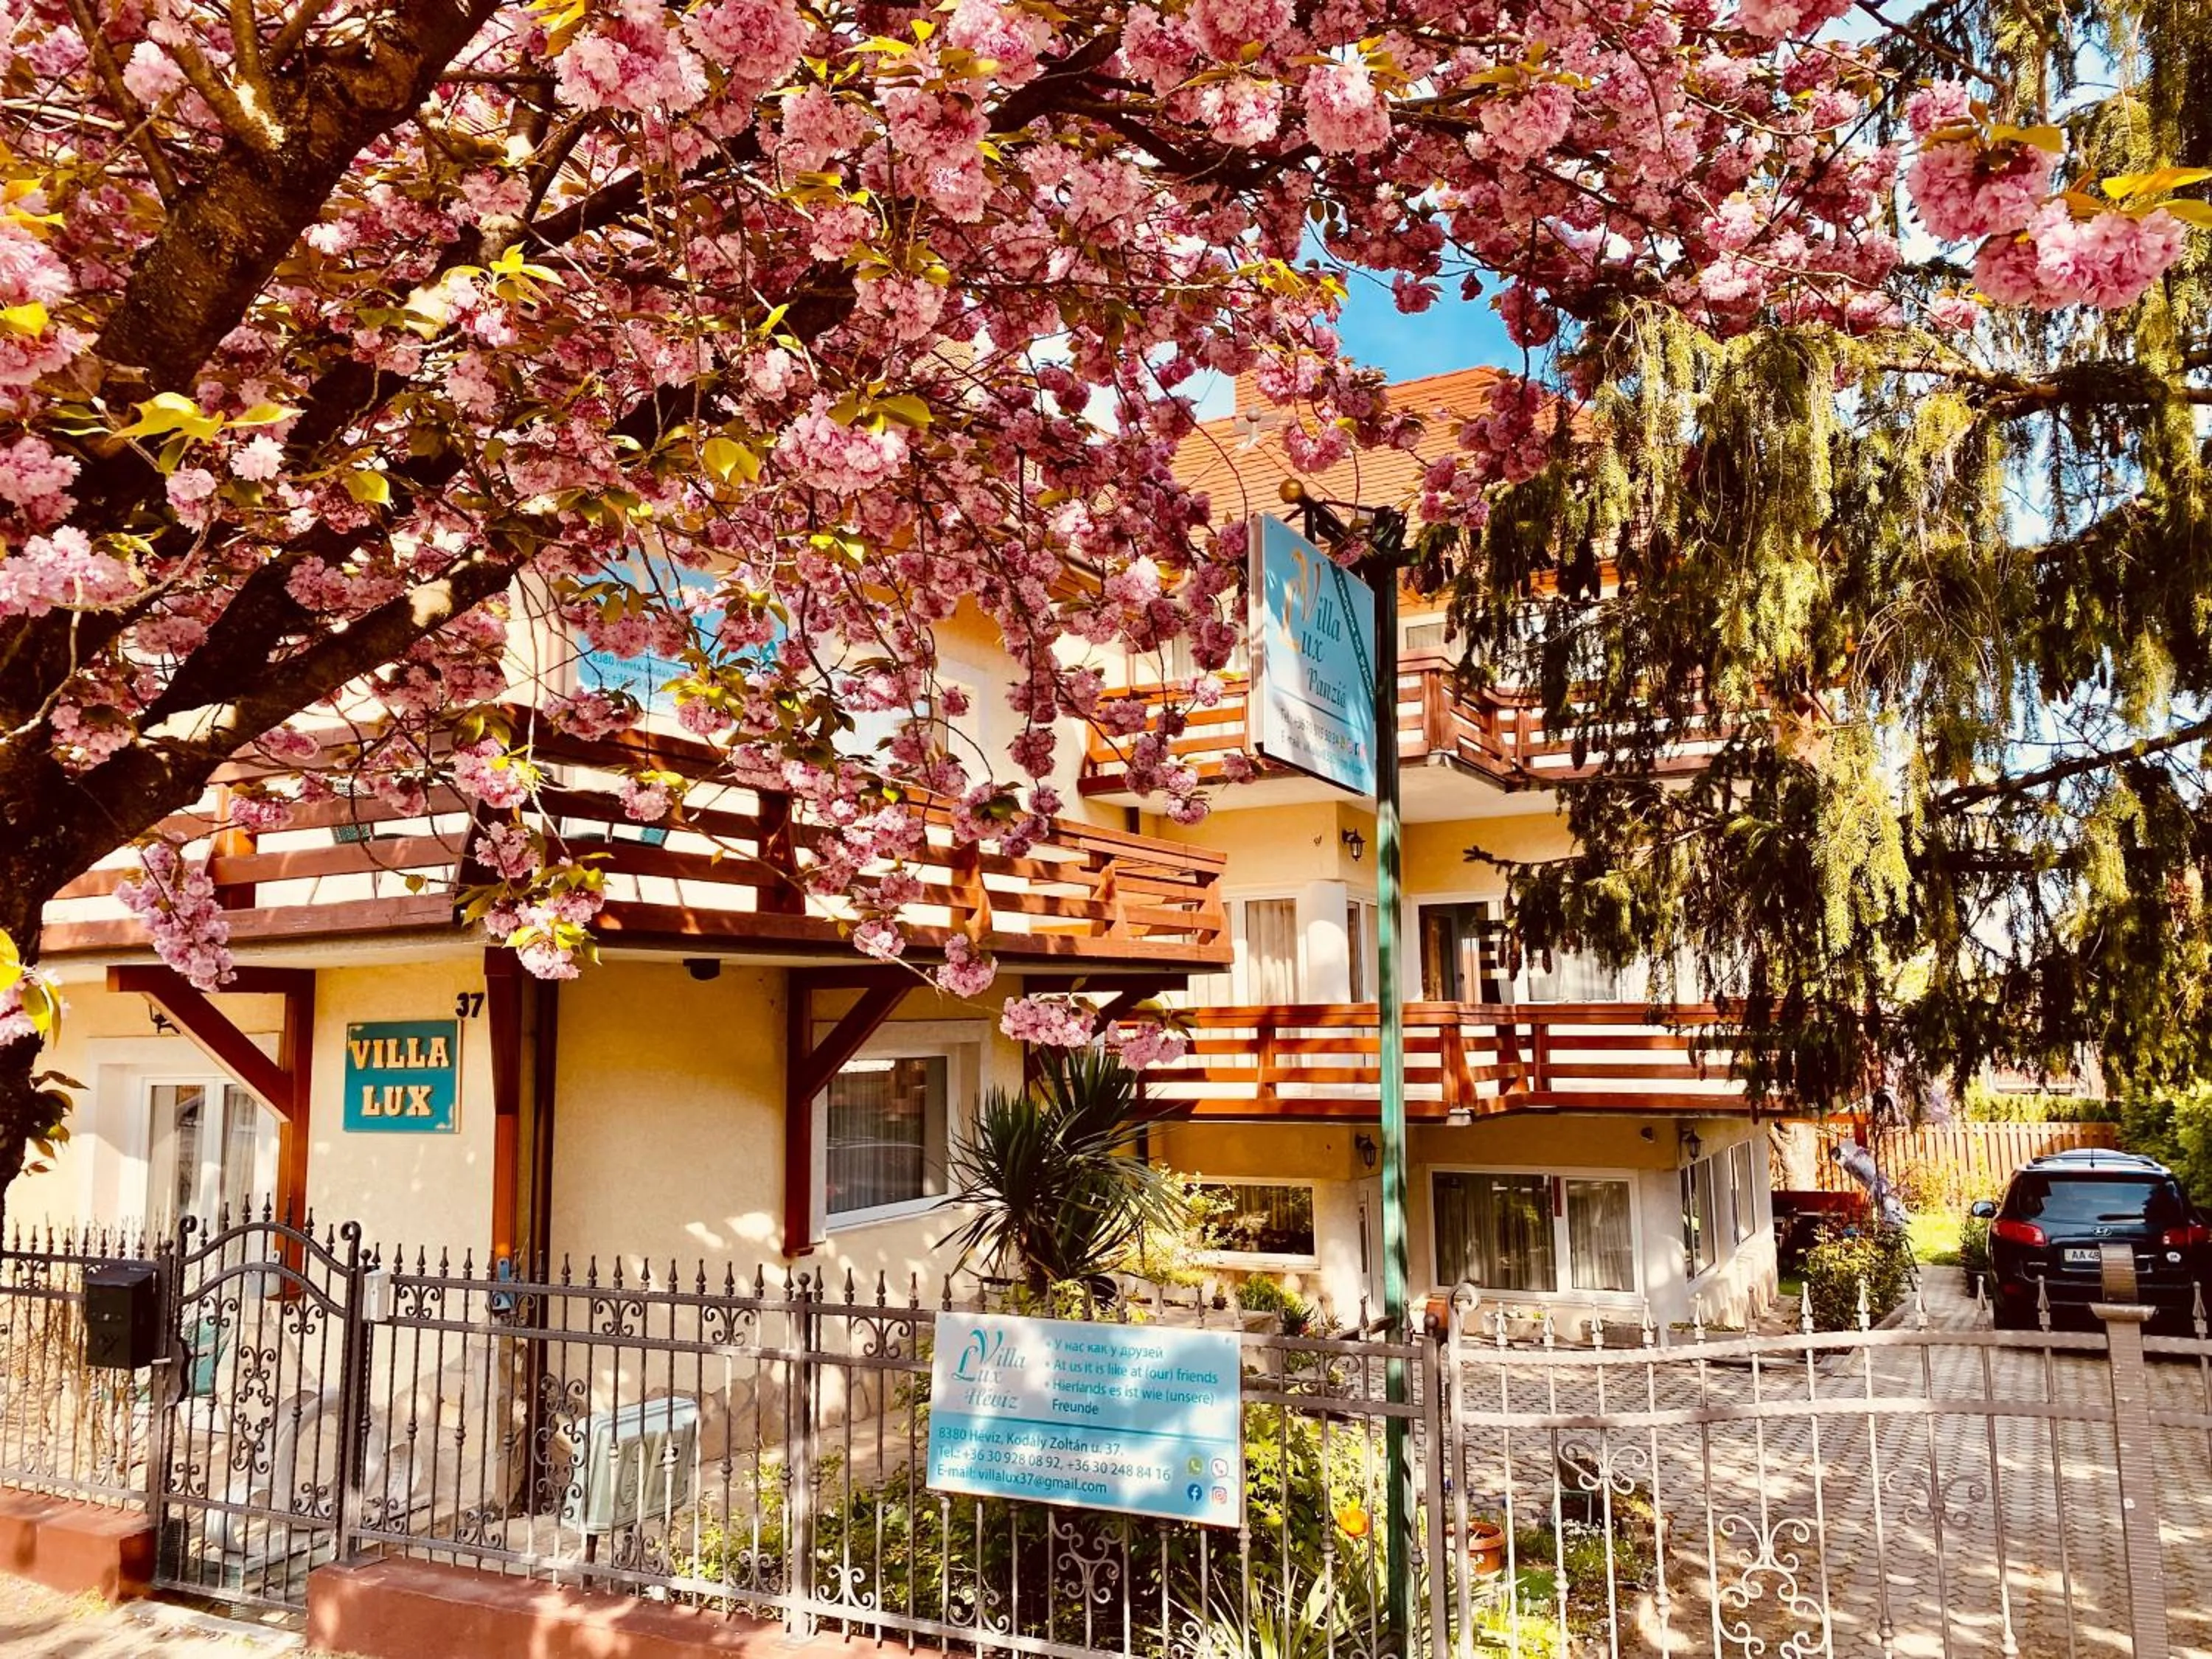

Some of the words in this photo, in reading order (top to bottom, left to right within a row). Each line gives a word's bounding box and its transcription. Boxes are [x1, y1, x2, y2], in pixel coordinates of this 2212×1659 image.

[1292, 549, 1341, 642] Villa
[1307, 668, 1346, 708] Panzió
[455, 992, 484, 1018] 37
[348, 1037, 449, 1070] VILLA
[361, 1085, 432, 1116] LUX
[970, 1329, 1026, 1369] Villa
[1054, 1338, 1062, 1351] У
[1065, 1342, 1084, 1353] нас
[1087, 1343, 1108, 1354] как
[1110, 1345, 1117, 1357] у
[1119, 1346, 1164, 1359] друзей
[951, 1346, 1003, 1384] Lux
[1054, 1359, 1066, 1371] At
[1069, 1361, 1082, 1373] us
[1084, 1361, 1093, 1374] it
[1095, 1362, 1105, 1375] is
[1107, 1362, 1127, 1377] like
[1130, 1366, 1142, 1377] at
[1145, 1366, 1173, 1381] (our)
[1176, 1368, 1219, 1384] friends
[1052, 1399, 1099, 1415] Freunde
[1108, 1386, 1121, 1397] es
[1124, 1384, 1138, 1398] ist
[1142, 1386, 1164, 1400] wie
[1165, 1388, 1215, 1406] (unsere)
[938, 1426, 967, 1440] 8380
[1006, 1432, 1047, 1451] Kodály
[1049, 1436, 1088, 1453] Zoltán
[1091, 1443, 1102, 1454] u.
[1106, 1442, 1124, 1457] 37.
[938, 1444, 961, 1459] Tel.:
[961, 1447, 984, 1461] +36
[987, 1450, 1002, 1463] 30
[1004, 1451, 1026, 1465] 928
[1029, 1455, 1043, 1467] 08
[1046, 1455, 1063, 1471] 92,
[1067, 1458, 1089, 1472] +36
[1092, 1460, 1108, 1475] 30
[1110, 1461, 1134, 1478] 248
[1136, 1464, 1152, 1480] 84
[1155, 1467, 1171, 1481] 16
[937, 1464, 975, 1480] E-mail:
[978, 1467, 1107, 1494] villalux37@gmail.com
